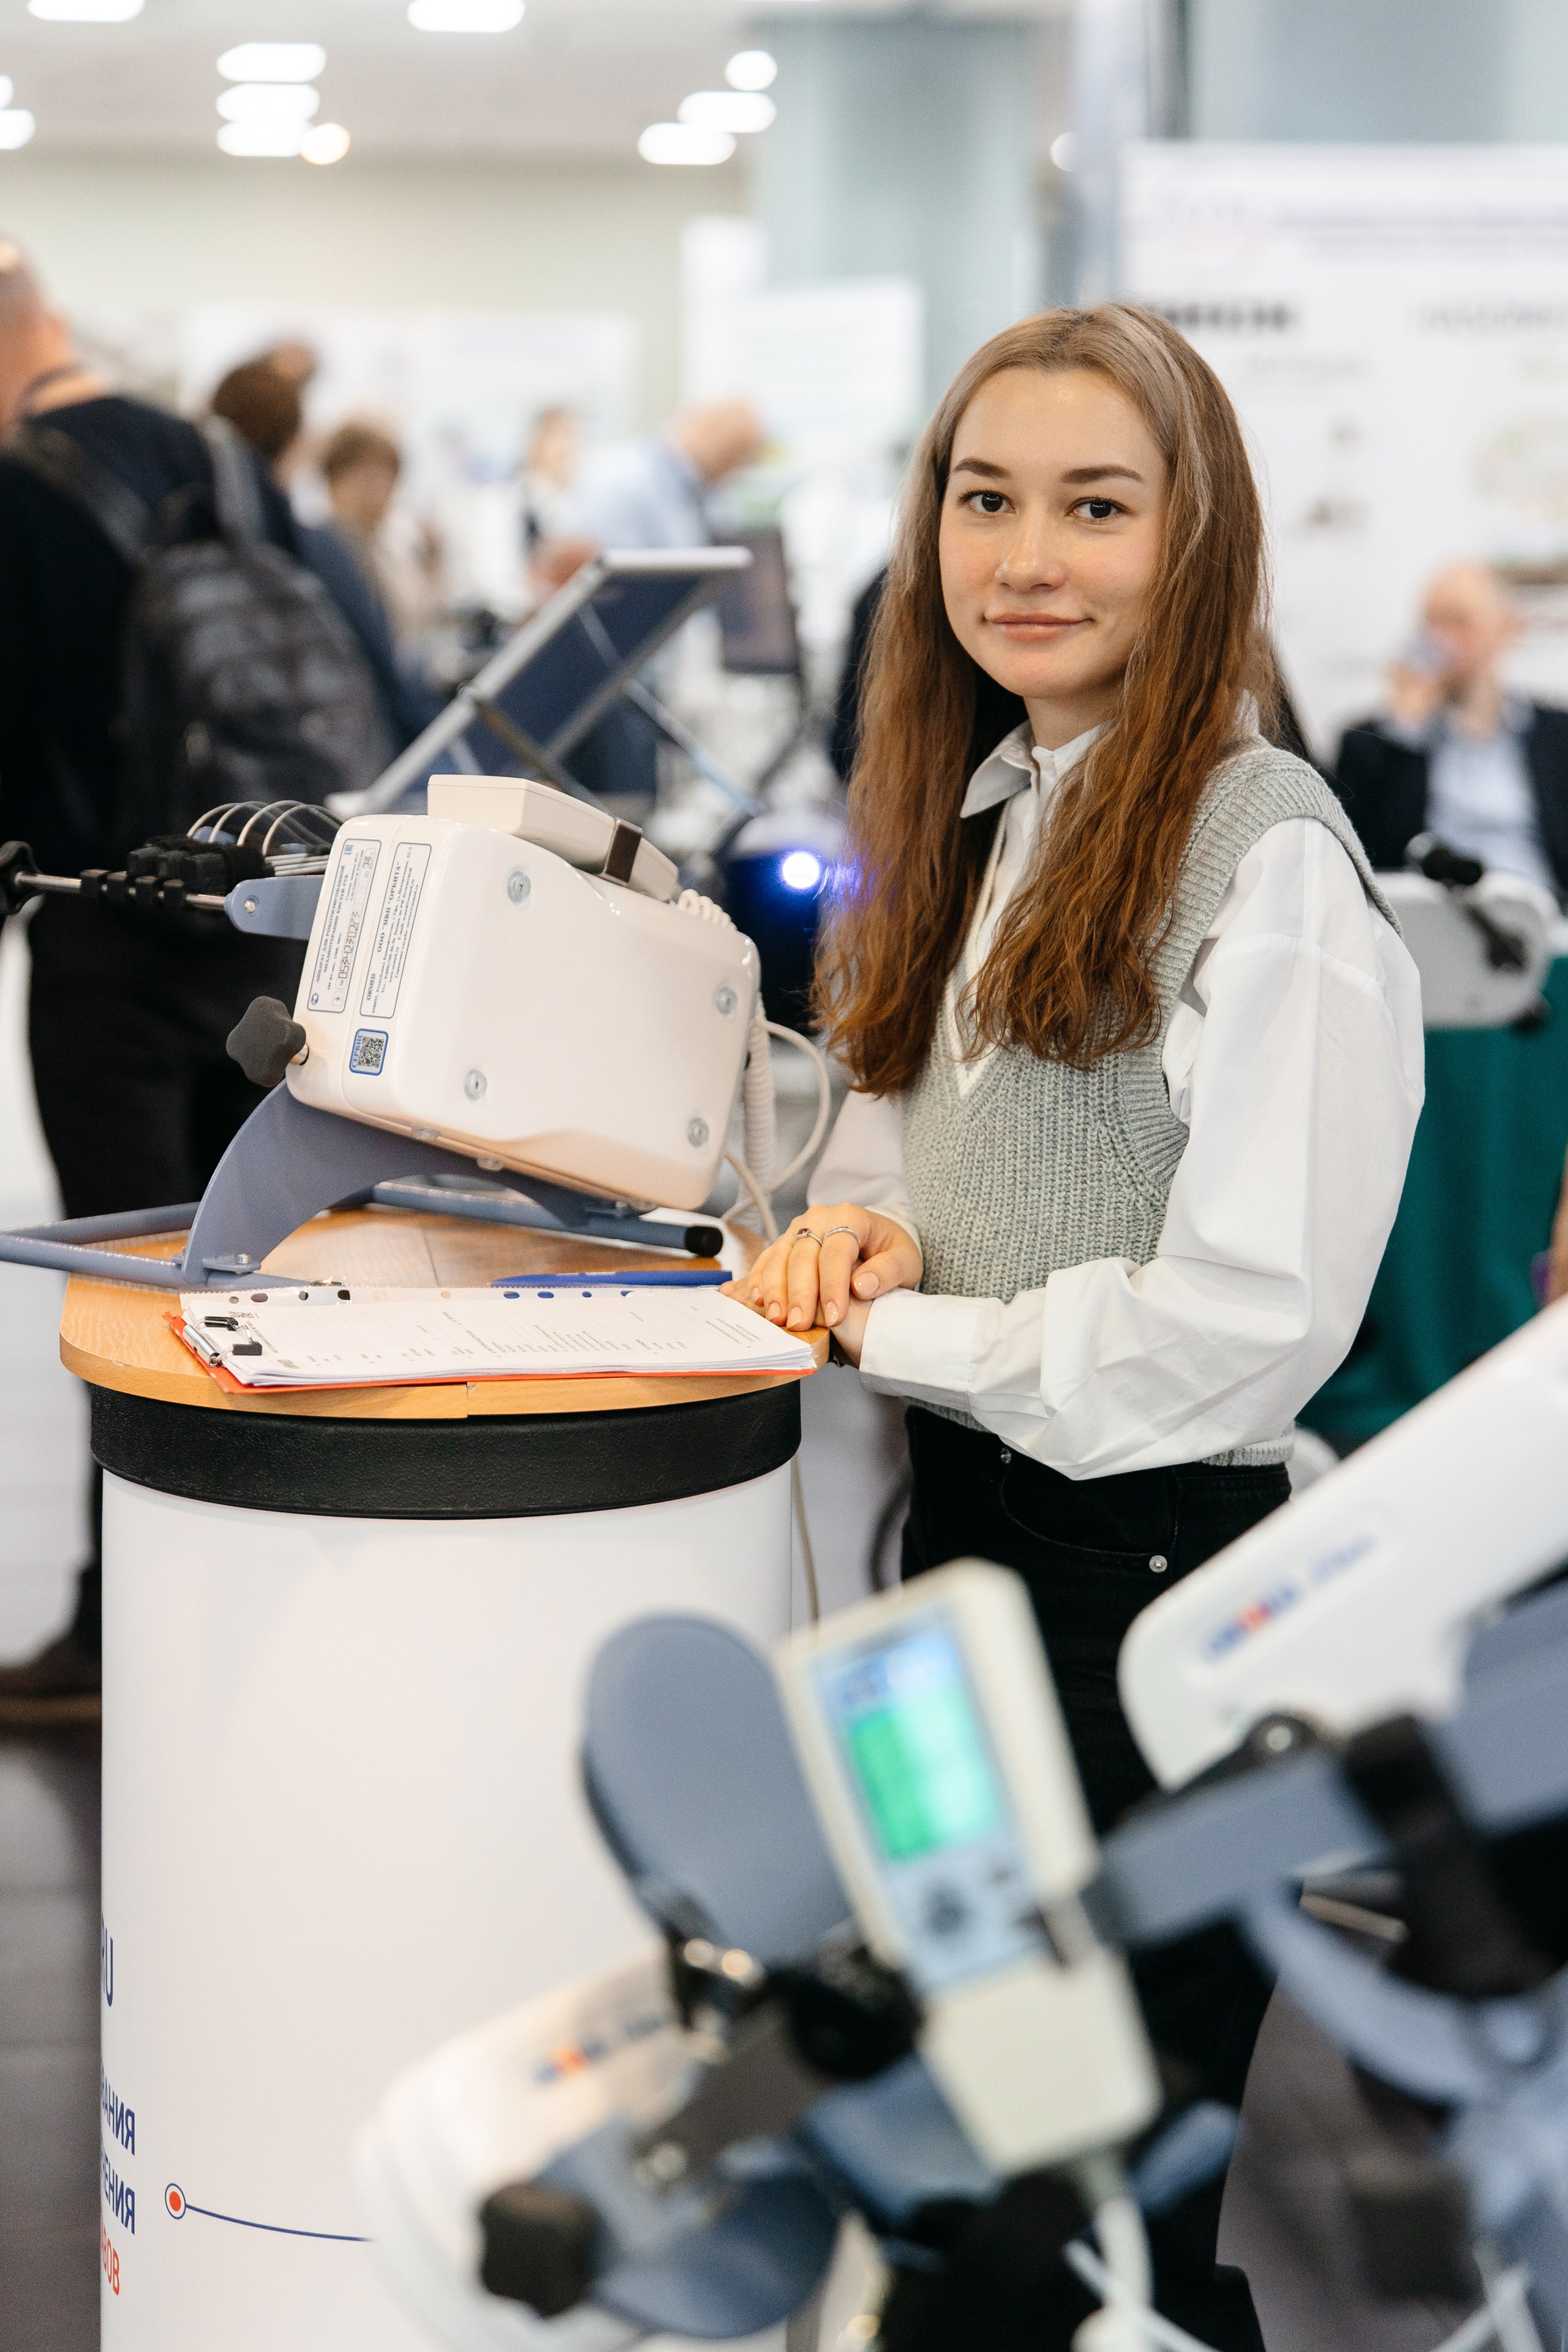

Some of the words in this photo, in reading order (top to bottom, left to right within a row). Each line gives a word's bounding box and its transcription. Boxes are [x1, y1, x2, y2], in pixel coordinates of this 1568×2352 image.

[349, 876, 358, 901] СДЕЛАНО
[356, 849, 364, 870] РОССИИ
[362, 856, 374, 869] 23
[399, 899, 405, 908] РФ
[402, 867, 412, 897] бесплатный
[315, 954, 325, 982] АППАРАТ
[325, 864, 345, 937] РОБОТИЗИРОВАННОЙ
[323, 915, 339, 972] МЕХАНОТЕРАПИИ
[336, 888, 345, 913] КИСТЕЙ
[366, 973, 376, 1000] ORMED
[376, 932, 385, 952] ООО
[375, 962, 386, 992] Республика
[394, 951, 404, 978] Сервисная
[350, 1032, 364, 1068] СЕРВИС
